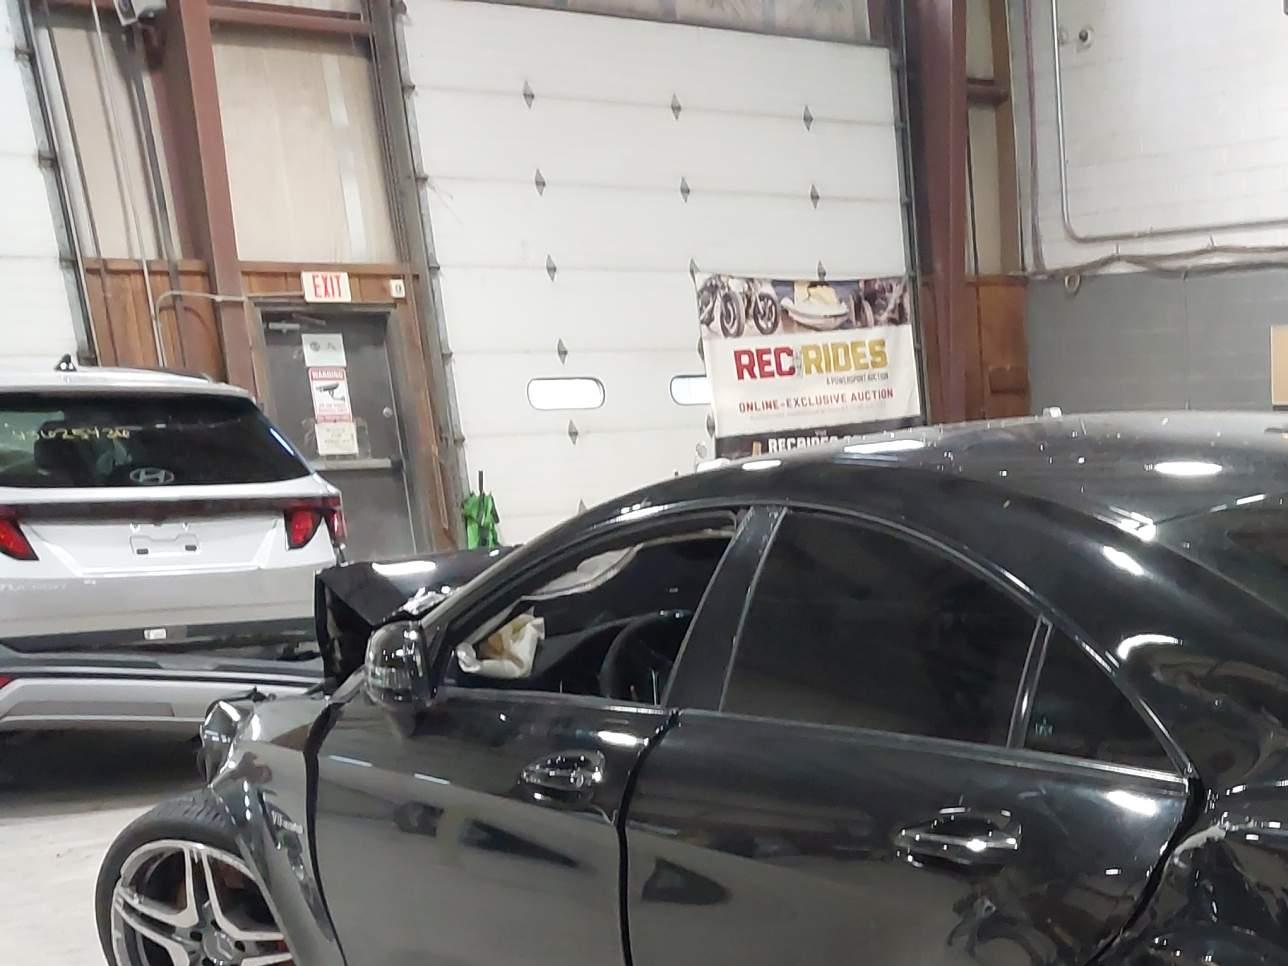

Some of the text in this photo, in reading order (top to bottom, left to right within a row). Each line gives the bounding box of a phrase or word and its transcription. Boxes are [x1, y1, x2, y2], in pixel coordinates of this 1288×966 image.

[311, 273, 342, 298] EXIT
[738, 392, 847, 414] ONLINE-EXCLUSIVE
[850, 387, 894, 403] AUCTION
